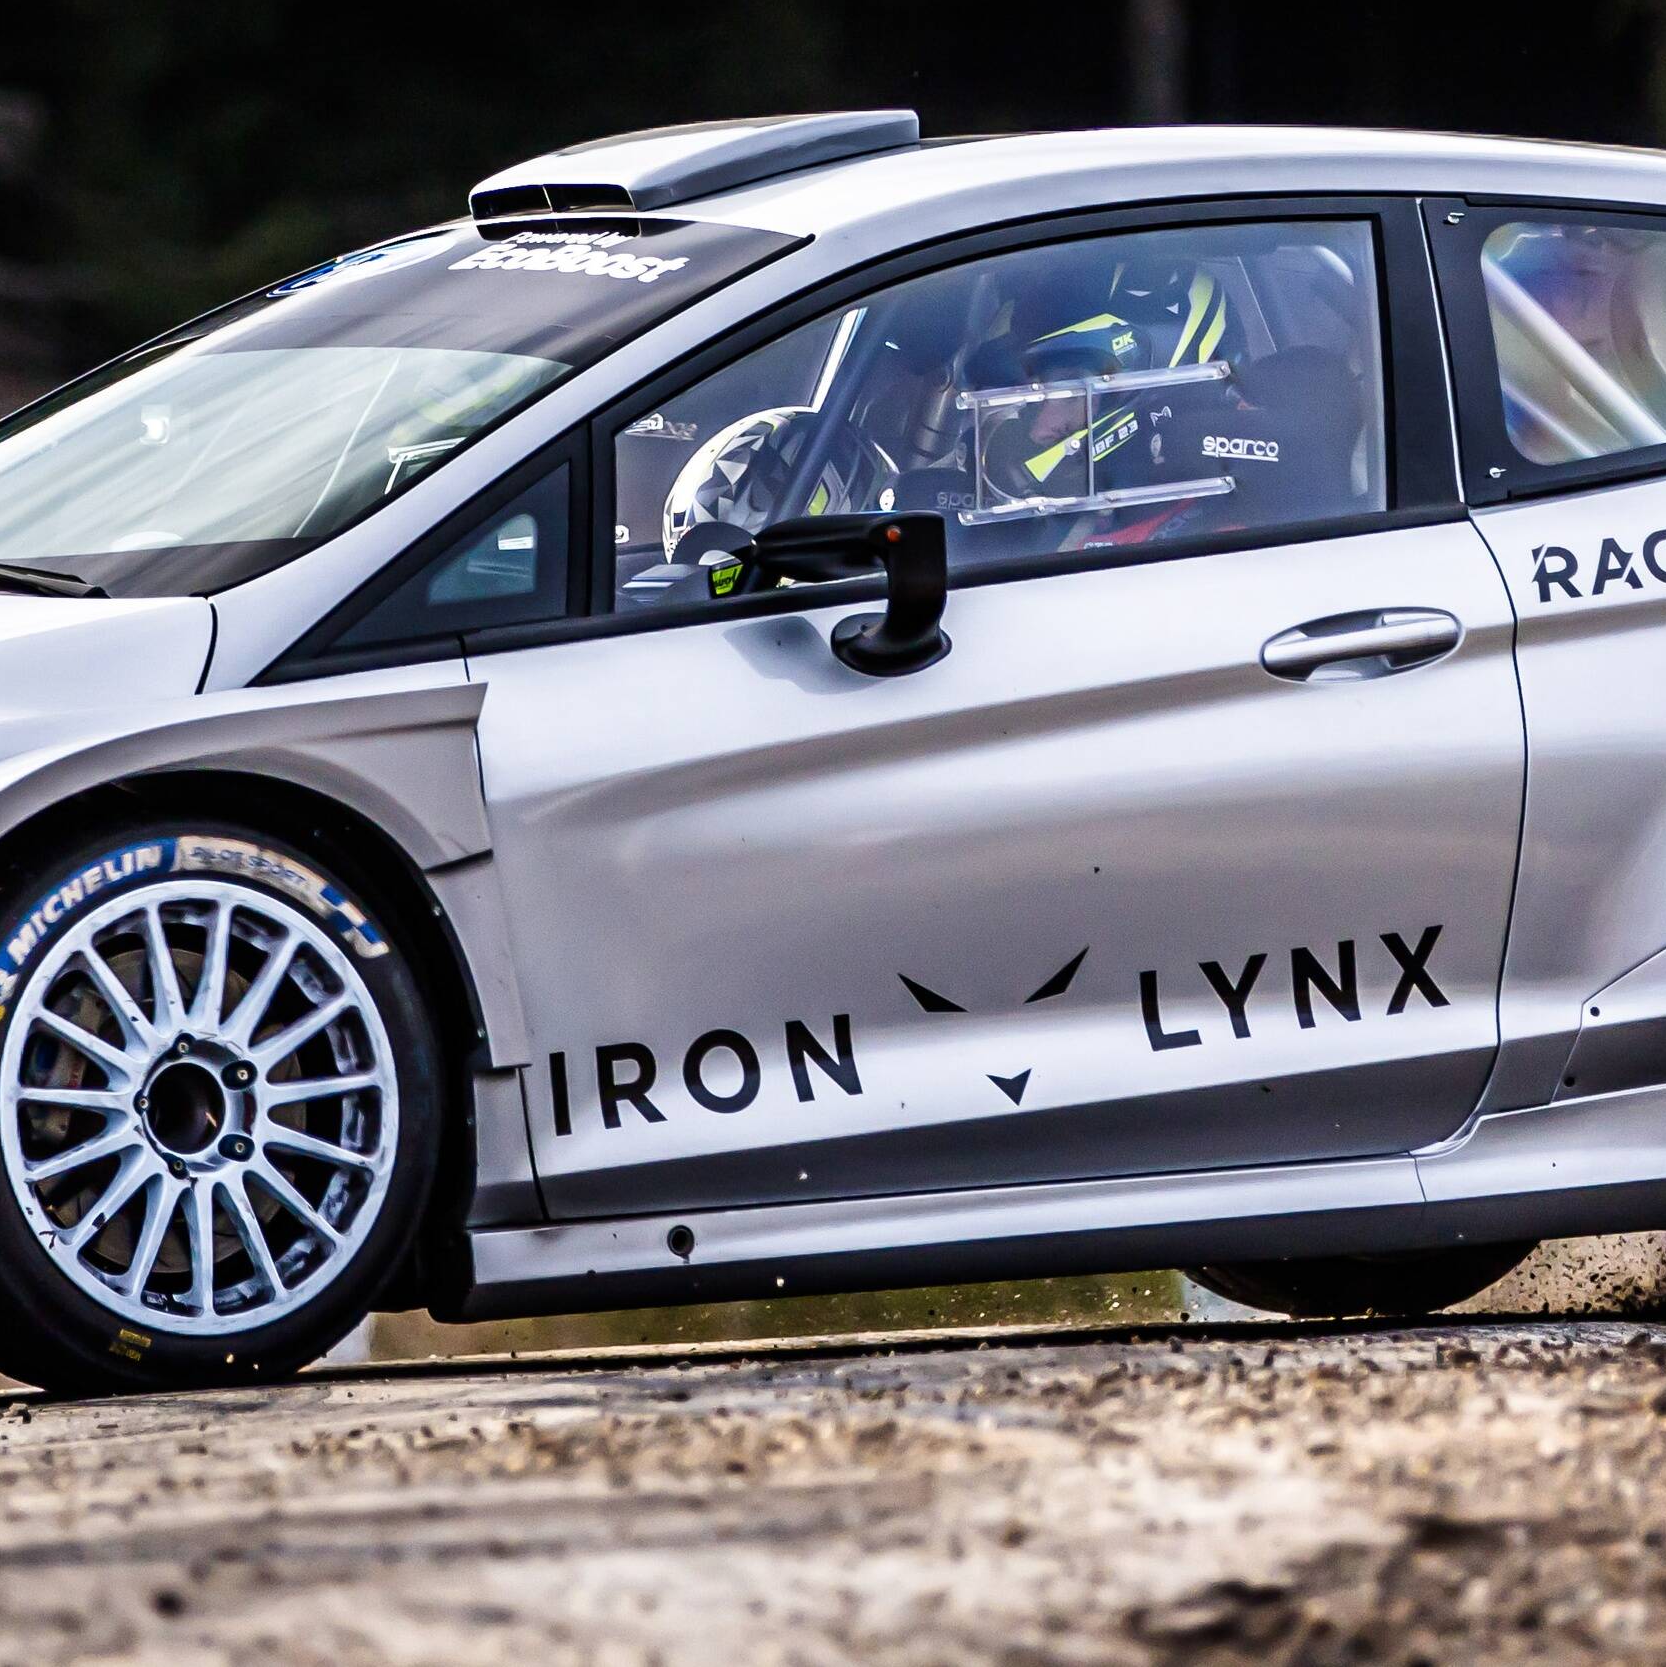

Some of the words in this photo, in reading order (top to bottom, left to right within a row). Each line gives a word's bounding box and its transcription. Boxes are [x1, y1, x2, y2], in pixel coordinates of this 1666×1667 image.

[447, 243, 691, 283] EcoBoost
[1201, 435, 1280, 463] sparco
[7, 845, 162, 966] MICHELIN
[549, 1013, 864, 1137] IRON
[1138, 924, 1451, 1052] LYNX
